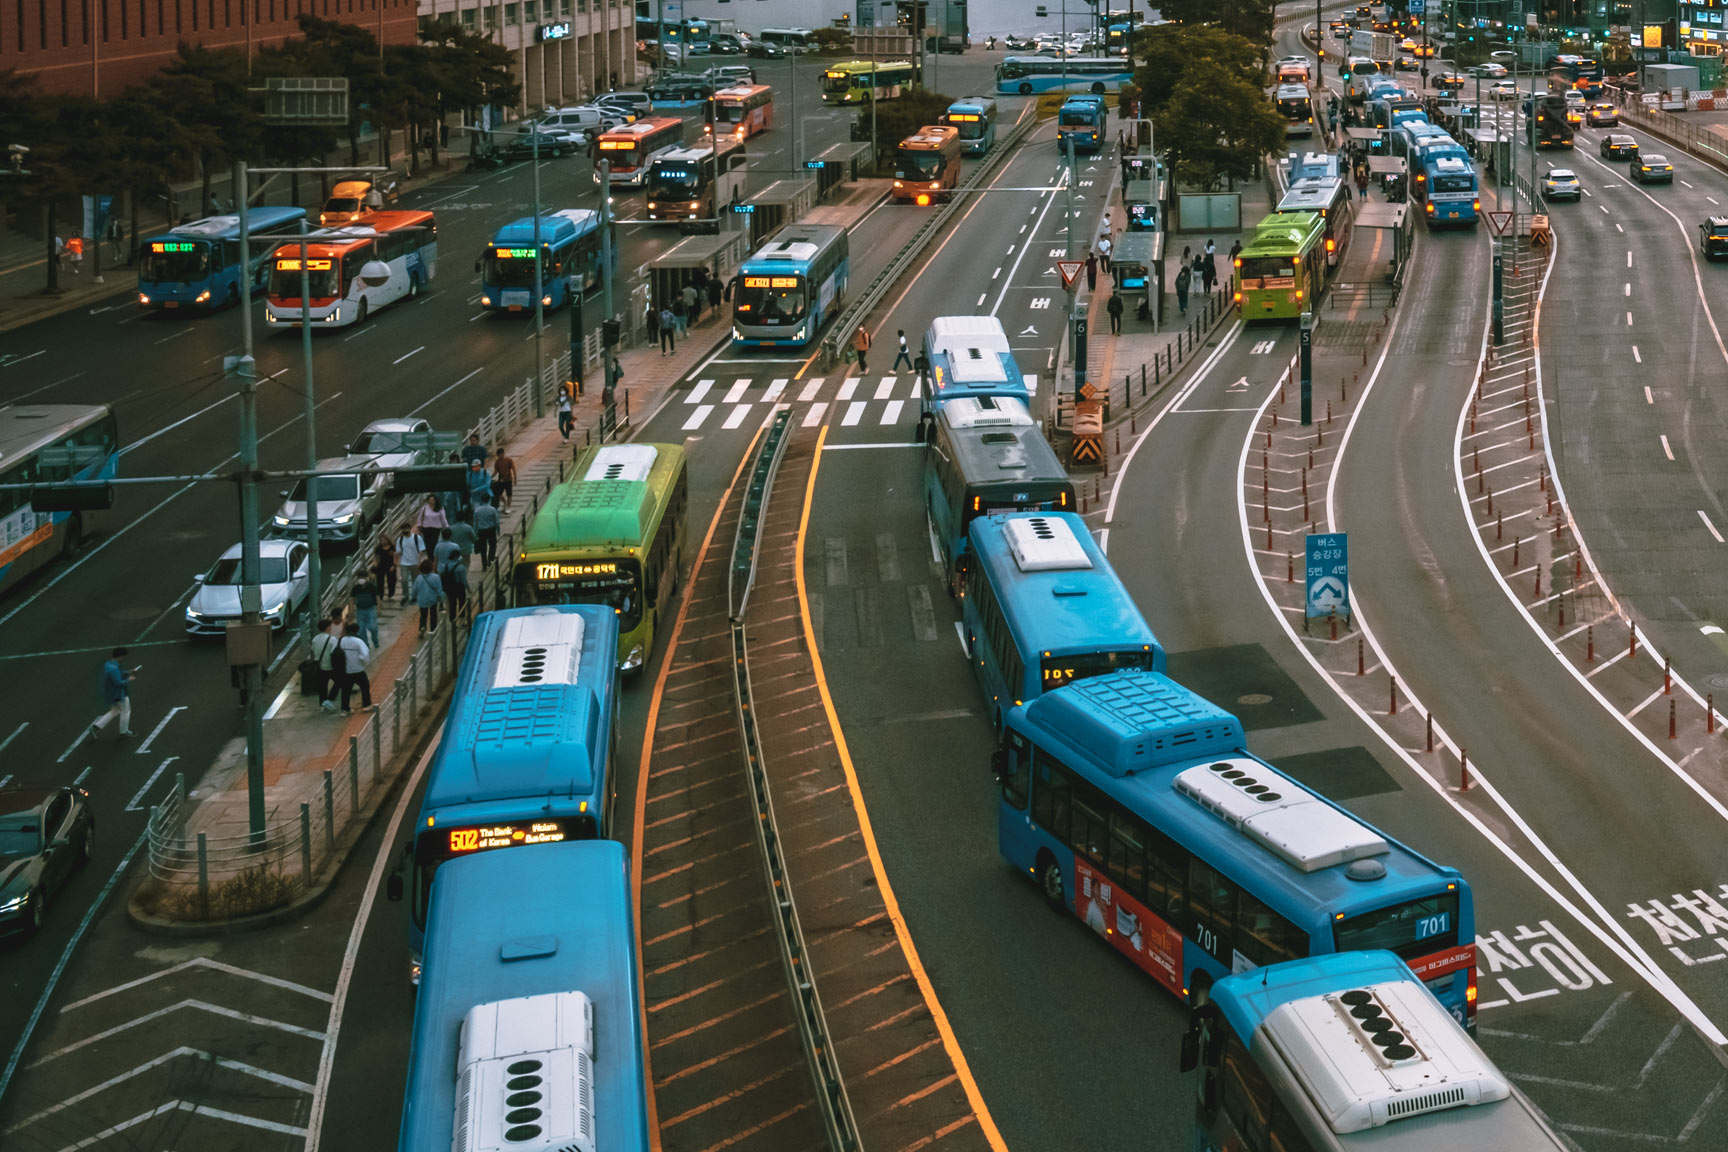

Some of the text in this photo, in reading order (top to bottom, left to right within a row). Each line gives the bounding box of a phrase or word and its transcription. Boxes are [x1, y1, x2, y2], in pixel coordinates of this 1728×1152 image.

[1494, 258, 1500, 267] 4
[573, 294, 580, 304] 7
[1077, 322, 1085, 333] 6
[1302, 332, 1309, 343] 5
[1317, 537, 1337, 547] 버스
[1312, 549, 1342, 561] 승강장
[536, 563, 559, 579] 1711
[1308, 564, 1347, 576] 5번 4번
[450, 830, 478, 851] 502
[479, 828, 494, 837] The
[479, 839, 487, 847] of
[1420, 914, 1446, 937] 701
[1197, 923, 1217, 956] 701
[1476, 920, 1613, 1010] 천히
